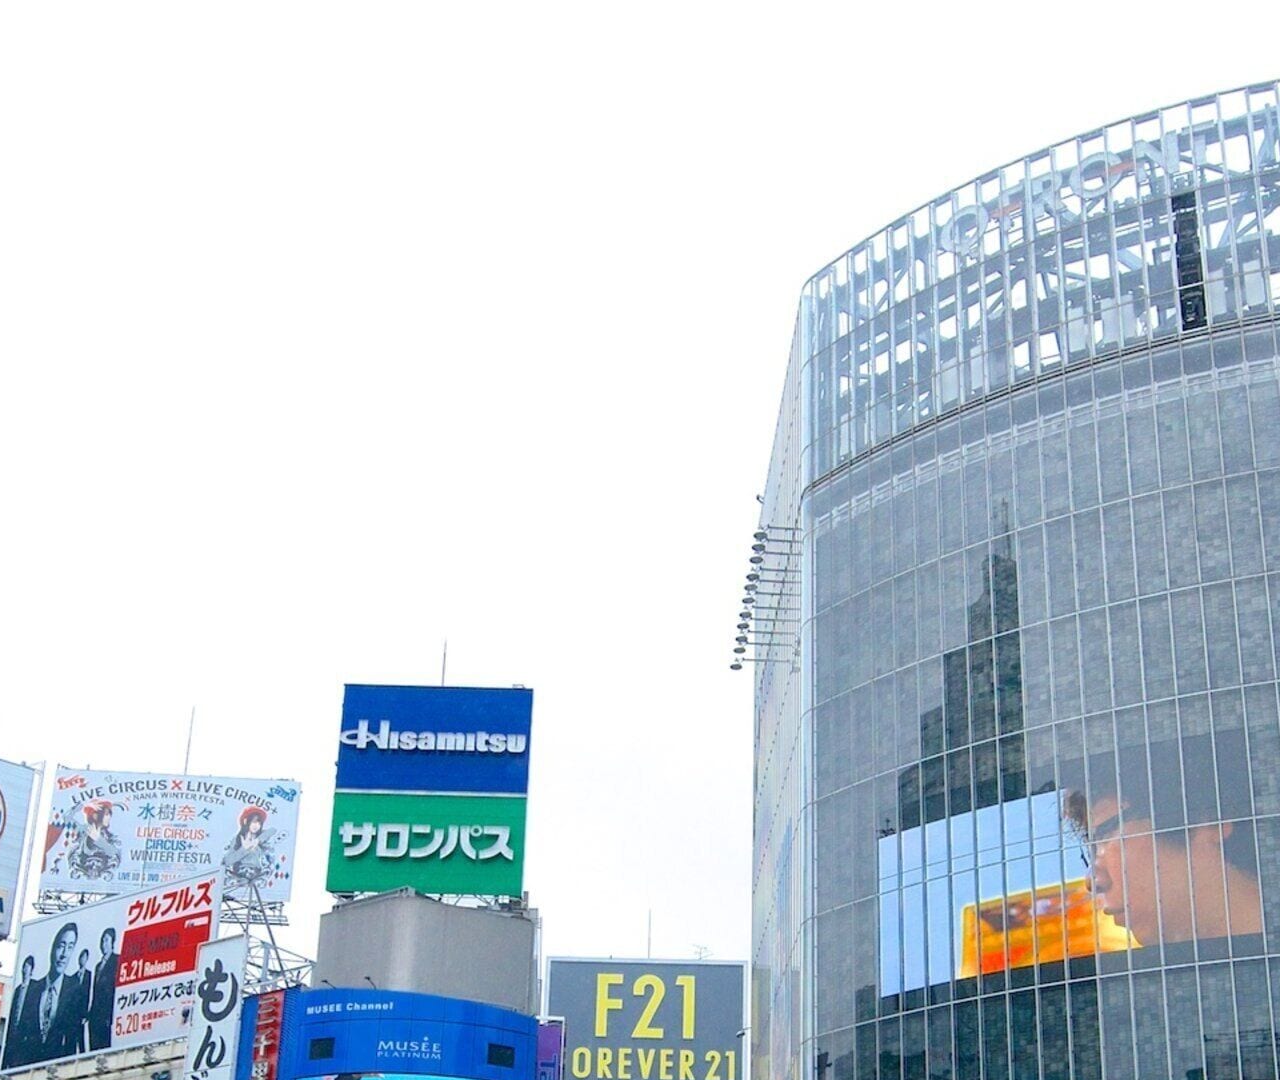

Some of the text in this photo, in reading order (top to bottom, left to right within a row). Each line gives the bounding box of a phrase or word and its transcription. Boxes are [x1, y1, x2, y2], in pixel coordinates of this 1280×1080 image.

[339, 719, 527, 755] Hisamitsu
[71, 786, 104, 804] LIVE
[109, 779, 168, 795] CIRCUS
[186, 781, 220, 796] LIVE
[160, 792, 197, 801] WINTER
[137, 802, 213, 822] 水樹奈々
[136, 827, 162, 839] LIVE
[339, 821, 514, 862] サロンパス
[130, 850, 212, 864] WINTER FESTA
[128, 878, 216, 925] ウルフルズ
[120, 959, 177, 983] 5.21 Release
[306, 1001, 394, 1015] MUSEE Channel
[595, 972, 697, 1040] F21
[115, 1013, 139, 1037] 5.20
[377, 1049, 442, 1061] PLATINUM
